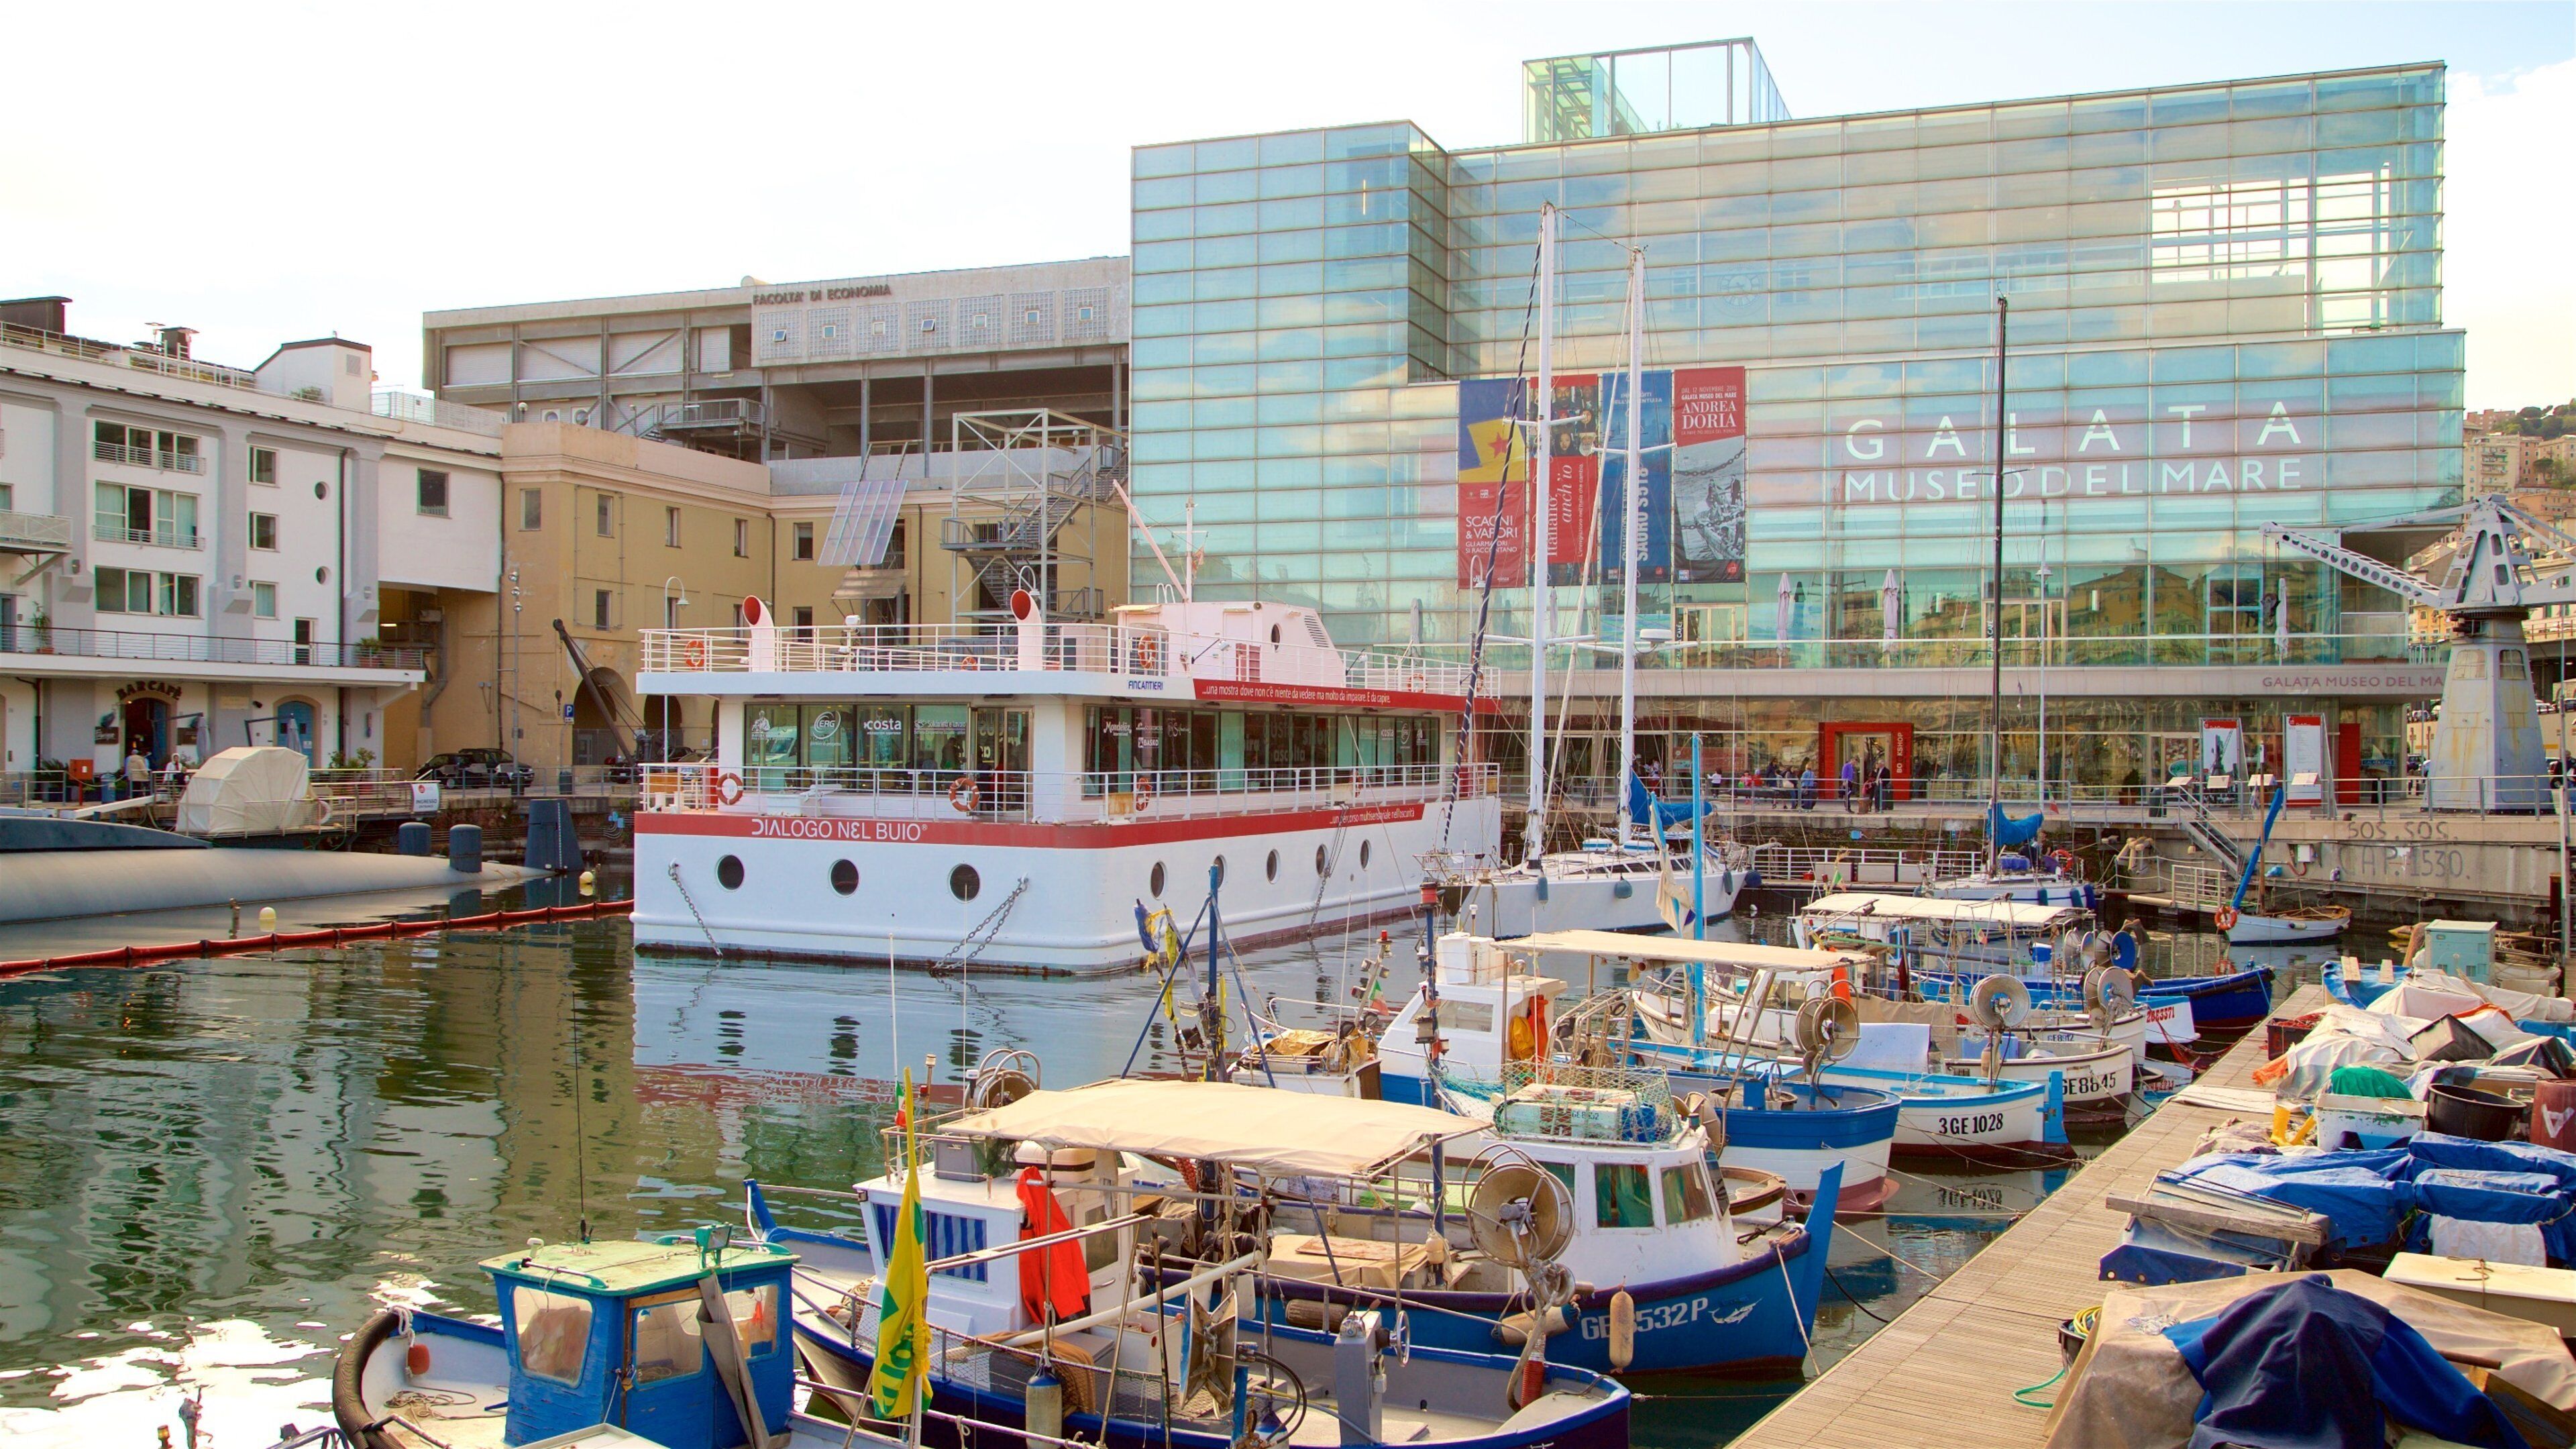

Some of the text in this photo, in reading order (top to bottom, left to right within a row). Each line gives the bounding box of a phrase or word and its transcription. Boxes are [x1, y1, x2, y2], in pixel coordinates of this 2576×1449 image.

[810, 290, 822, 301] DI
[826, 284, 892, 301] ECONOMIA
[1682, 400, 1737, 414] ANDREA
[1681, 413, 1736, 429] DORIA
[1845, 401, 2302, 460] GALATA
[1845, 458, 2302, 503] MUSEO DEL MARE
[1465, 530, 1473, 539] &
[1637, 511, 1649, 562] SAURO
[115, 680, 146, 700] BAR
[1128, 680, 1163, 690] FINCANTIERI
[2262, 676, 2443, 688] GALATA MUSEO DEL MA
[1218, 686, 1238, 696] mostra
[1240, 685, 1254, 696] dove
[1254, 688, 1265, 697] non
[1275, 687, 1291, 698] niente
[1291, 688, 1298, 698] da
[1299, 688, 1316, 700] vedere
[1316, 692, 1324, 700] ma
[1325, 690, 1339, 701] molto
[1339, 690, 1345, 701] da
[1367, 692, 1370, 702] E
[566, 705, 572, 716] P
[819, 720, 835, 728] ERG
[867, 718, 902, 731] costa
[1972, 1112, 2004, 1134] 1028
[1580, 1297, 1709, 1340] GE532P
